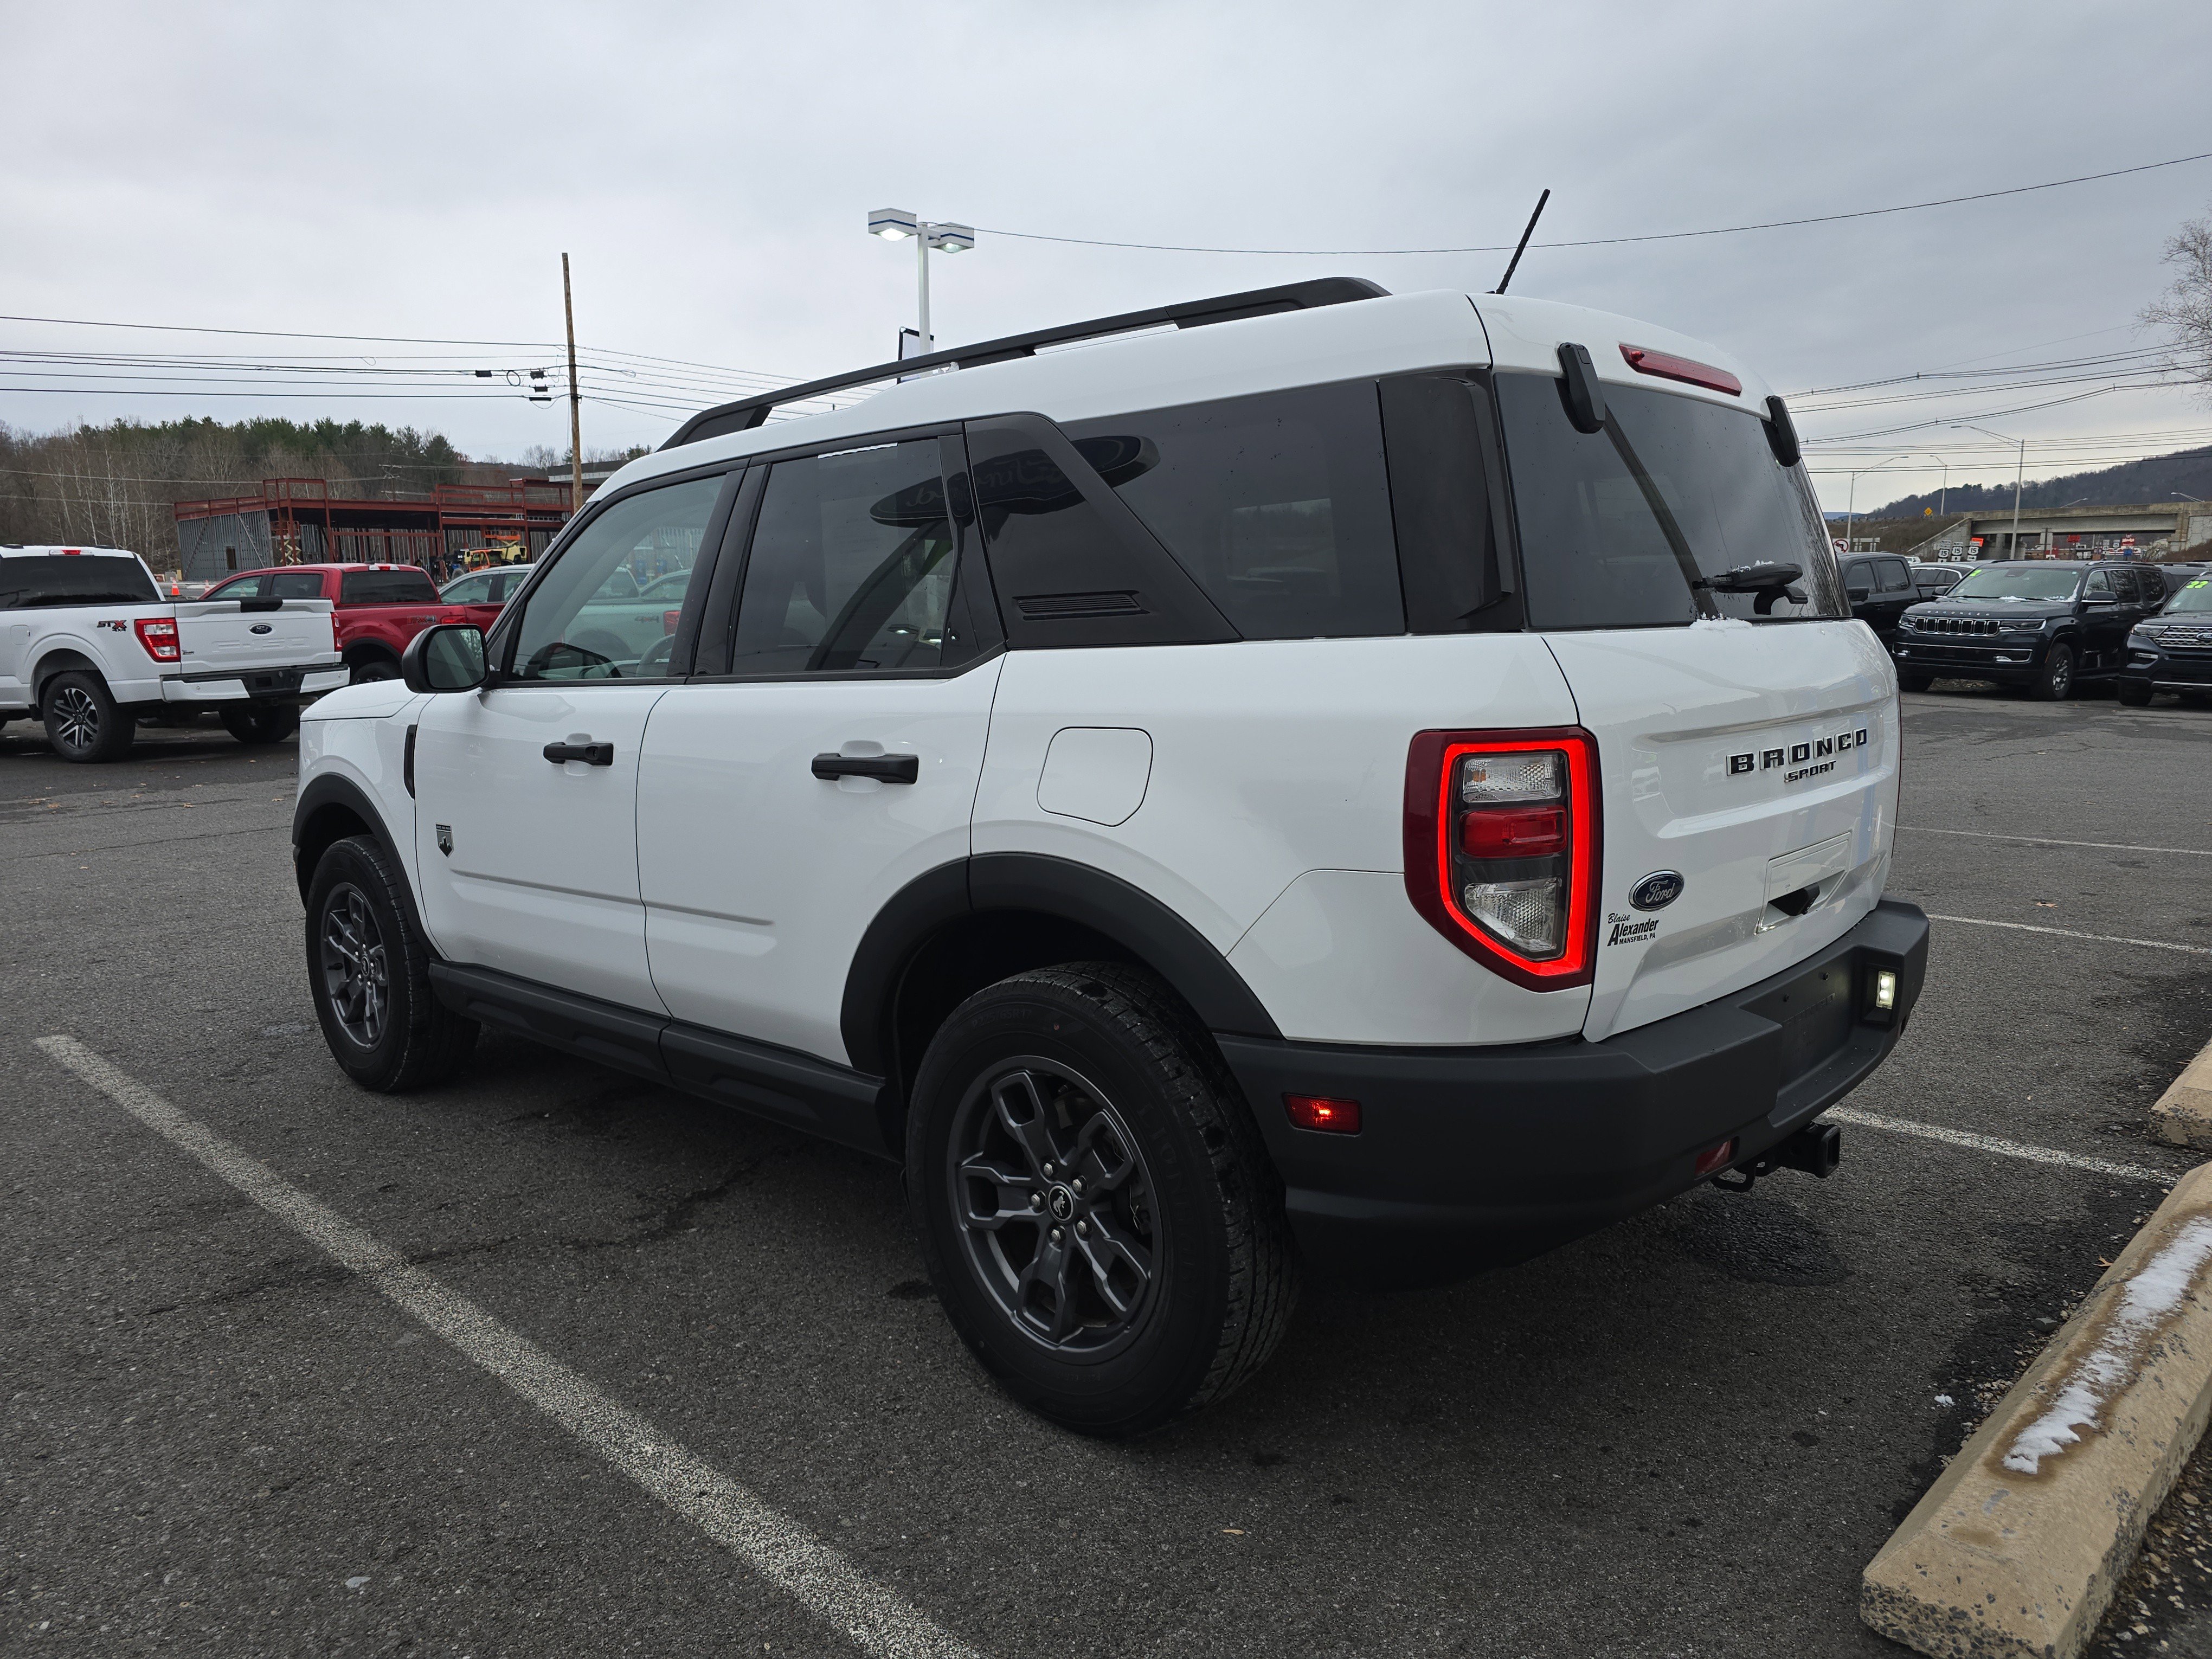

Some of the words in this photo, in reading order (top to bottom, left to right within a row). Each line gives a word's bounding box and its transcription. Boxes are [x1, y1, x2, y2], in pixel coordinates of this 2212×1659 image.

[2186, 581, 2209, 589] 22
[97, 620, 127, 629] STX
[1726, 728, 1867, 776] BRONCO
[1784, 760, 1836, 782] SPORT
[1645, 879, 1676, 904] Ford
[1608, 913, 1630, 923] Blaise
[1607, 918, 1659, 947] Alexander
[1619, 934, 1648, 944] MANSFIELD,
